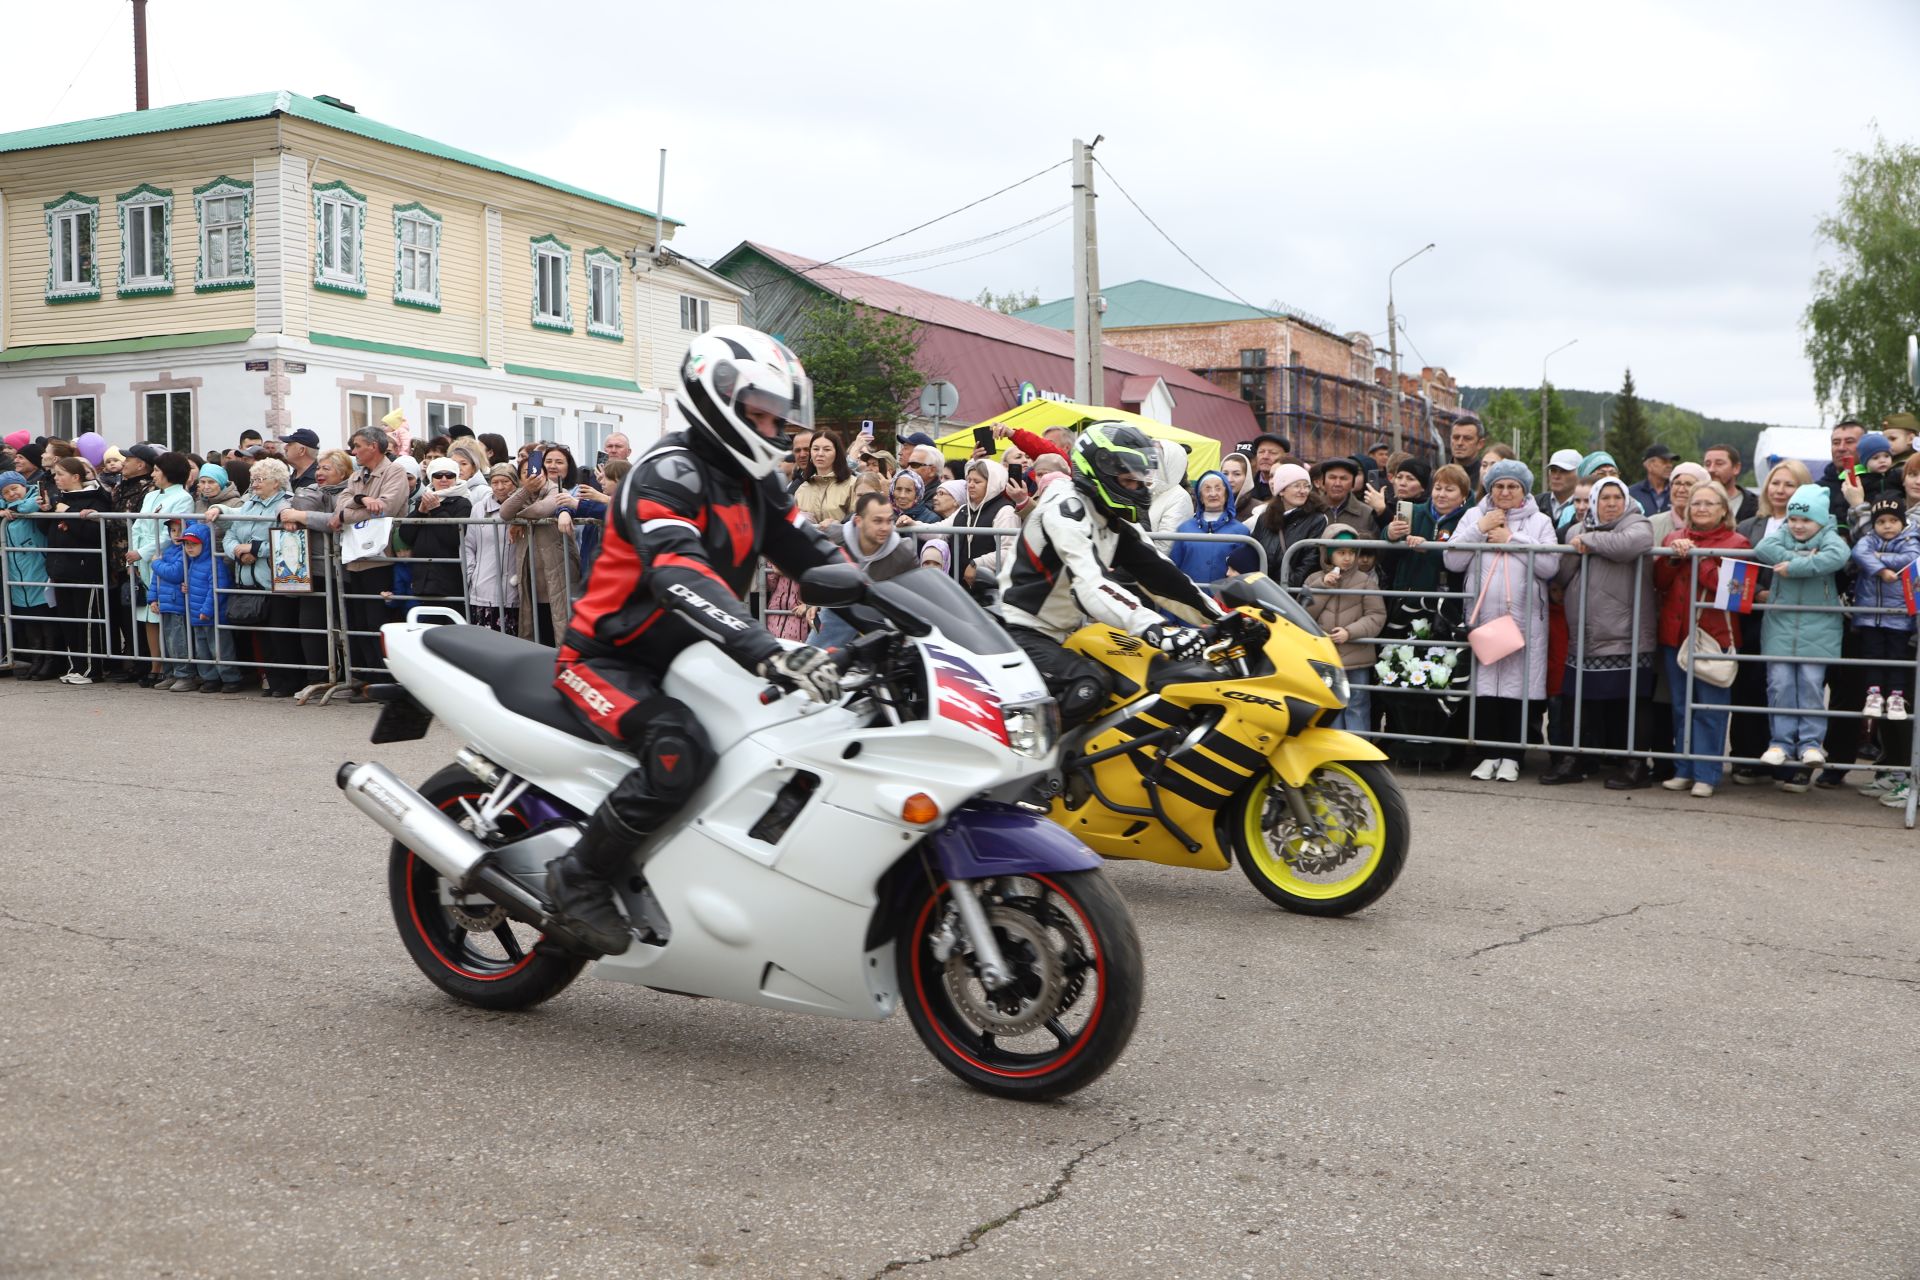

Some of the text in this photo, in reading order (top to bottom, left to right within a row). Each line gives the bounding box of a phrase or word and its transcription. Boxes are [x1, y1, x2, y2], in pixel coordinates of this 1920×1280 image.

[667, 584, 751, 631] DAINESE
[1106, 650, 1144, 658] HONDA
[1222, 691, 1285, 712] CBR
